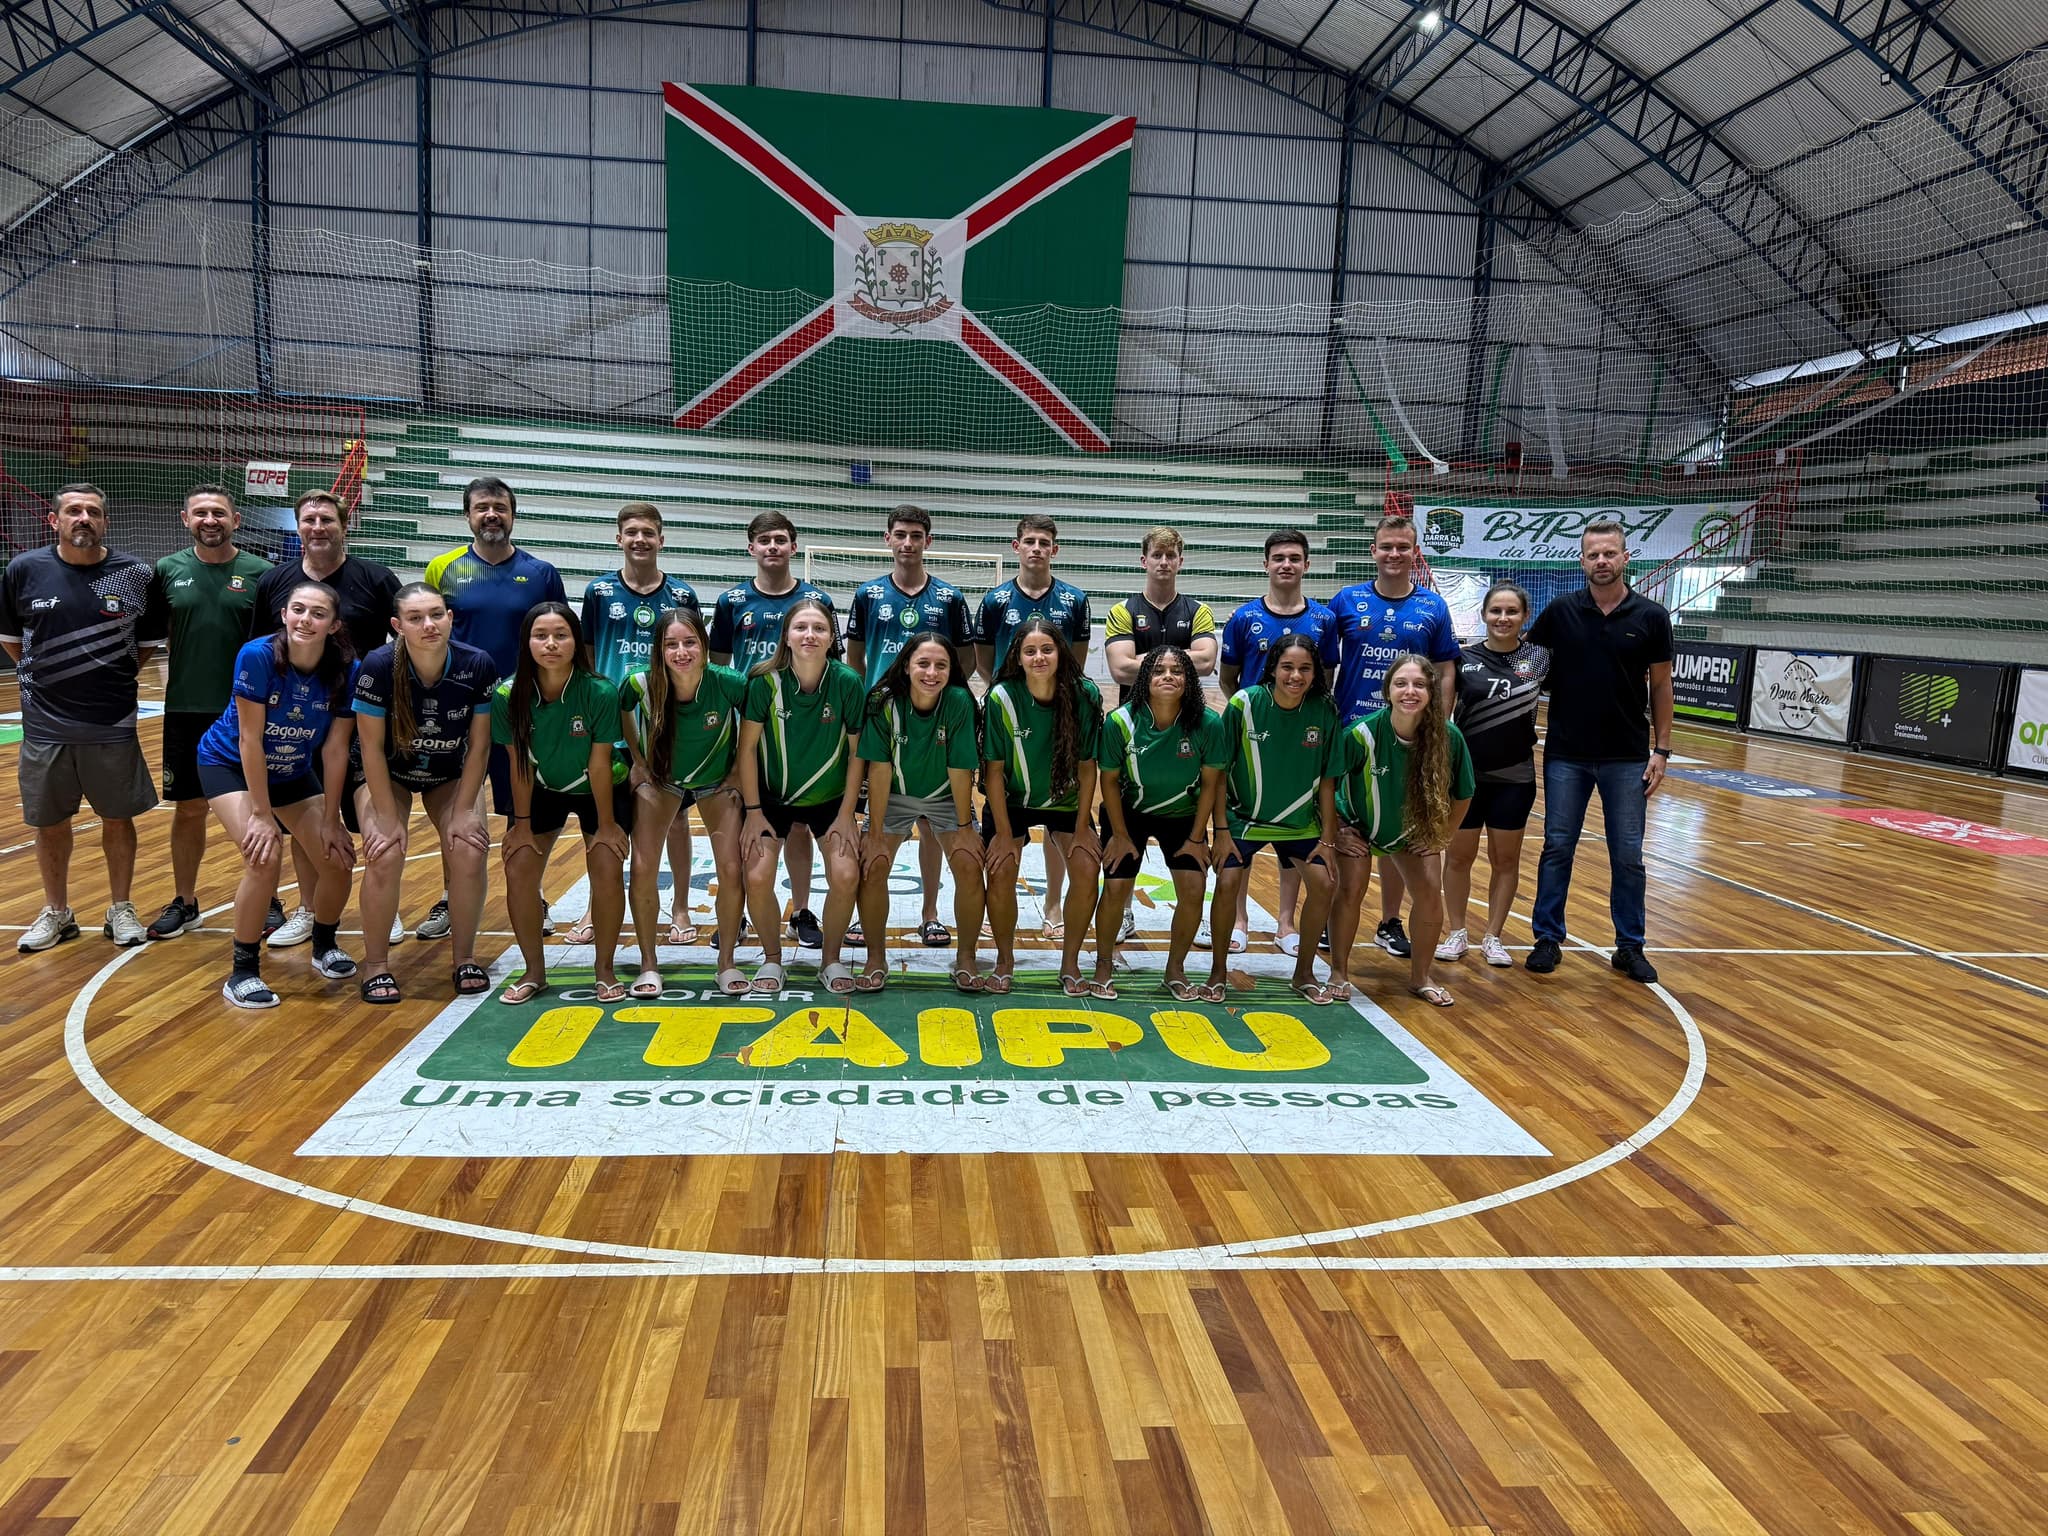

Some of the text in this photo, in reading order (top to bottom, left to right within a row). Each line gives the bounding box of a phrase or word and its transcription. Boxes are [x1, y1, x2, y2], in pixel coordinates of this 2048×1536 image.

[1500, 543, 1525, 558] da
[1671, 654, 1738, 684] JUMPER!
[1487, 678, 1511, 700] 73
[1770, 682, 1797, 701] Dona
[1894, 722, 1922, 733] Centro de
[926, 924, 946, 932] FILA
[460, 968, 484, 976] FILA
[368, 977, 395, 987] FILA
[506, 1006, 1332, 1072] ITAIPU
[399, 1083, 1459, 1112] Uma sociedade de pessoas
